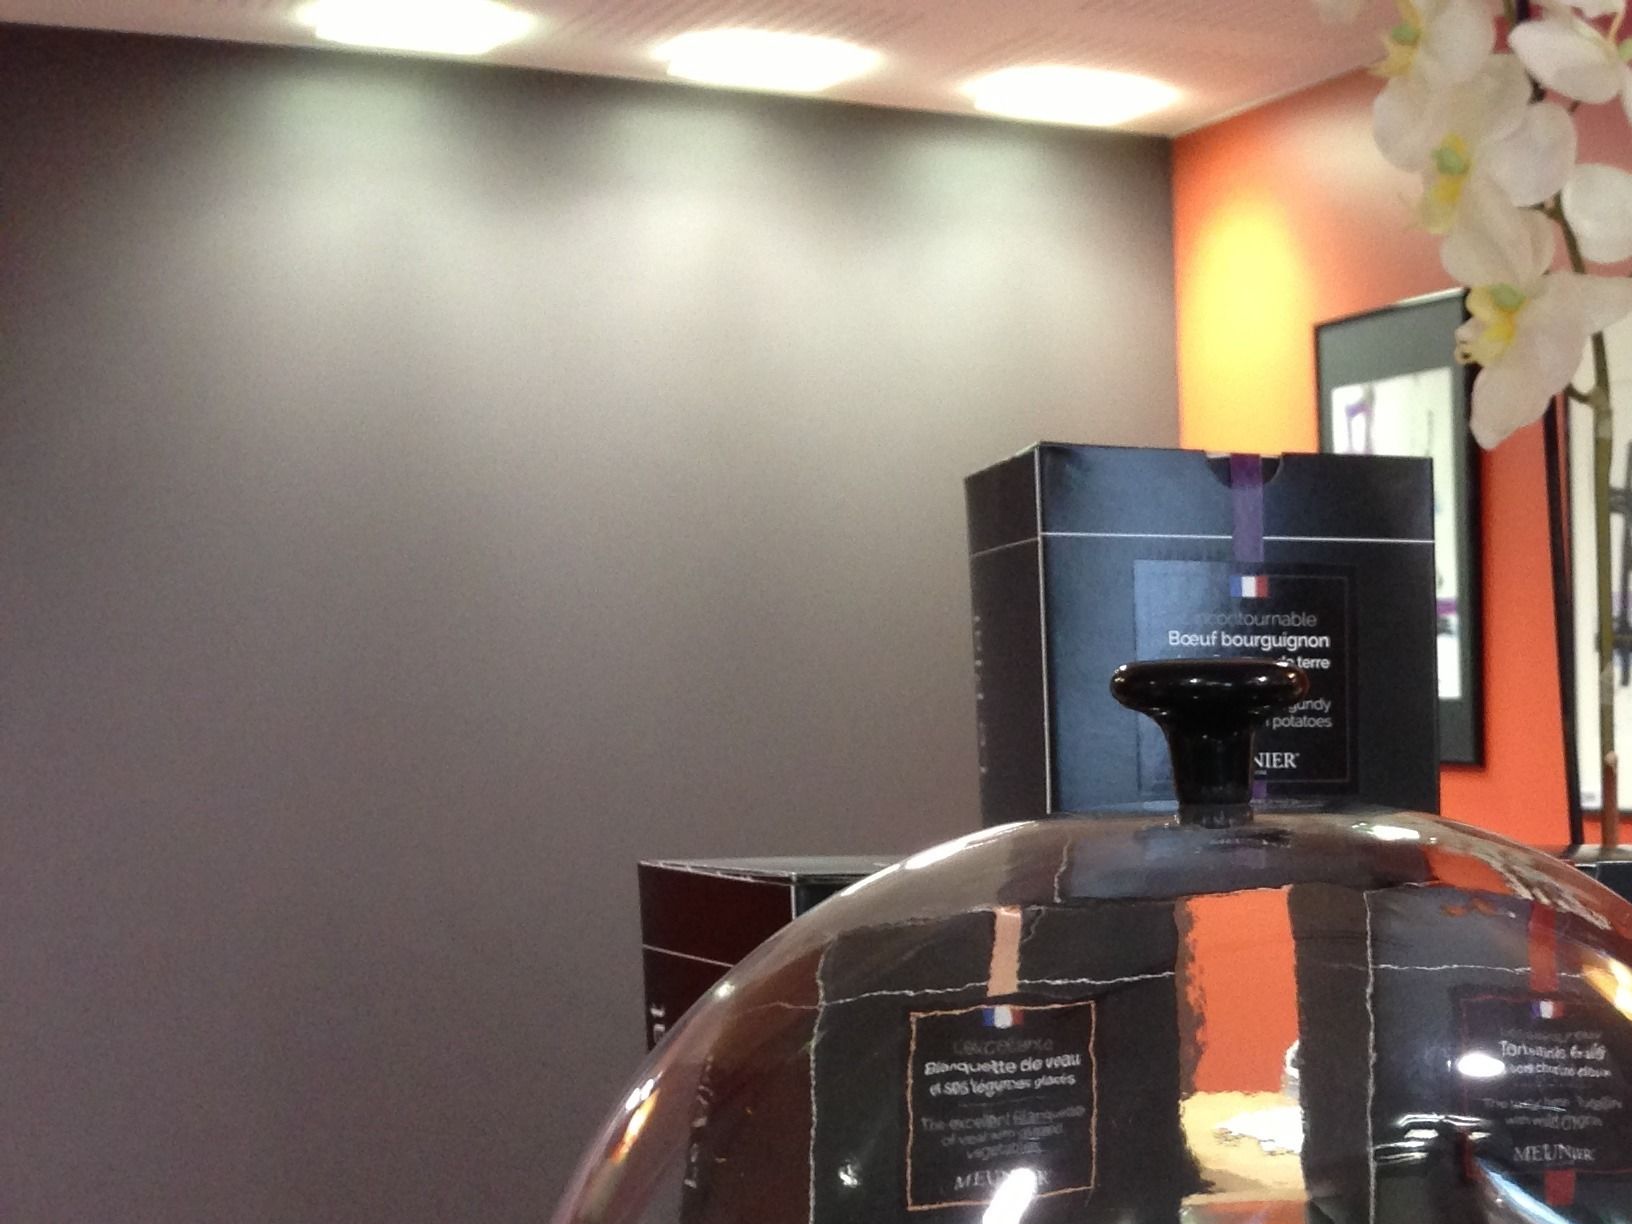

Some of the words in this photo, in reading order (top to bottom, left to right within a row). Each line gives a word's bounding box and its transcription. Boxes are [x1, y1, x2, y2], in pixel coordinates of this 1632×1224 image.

[1168, 630, 1217, 646] Bœuf
[1221, 631, 1330, 651] bourguignon
[1297, 656, 1330, 669] terre
[1272, 715, 1333, 730] potatoes
[1513, 1143, 1596, 1162] MEUNIER
